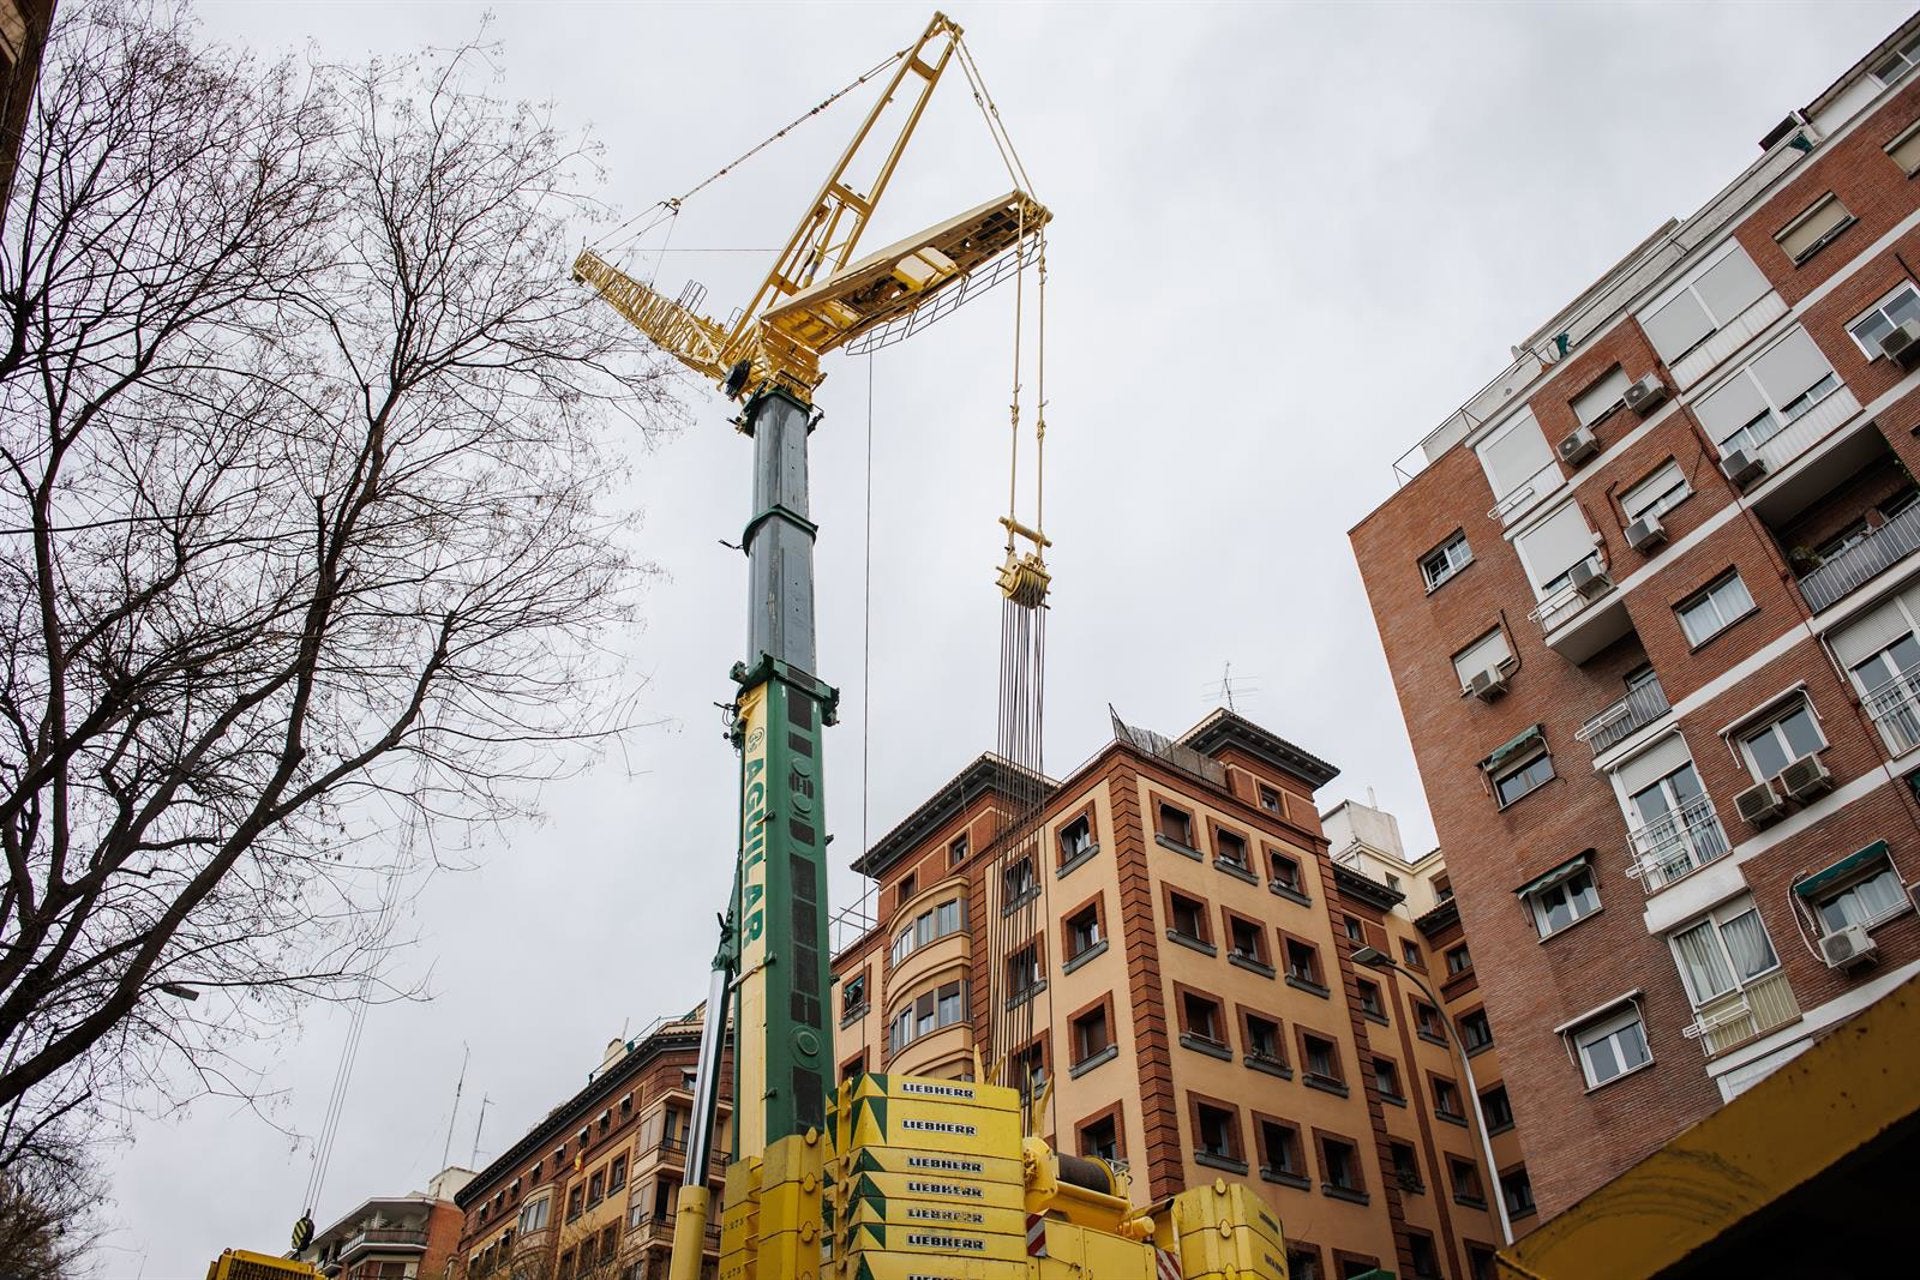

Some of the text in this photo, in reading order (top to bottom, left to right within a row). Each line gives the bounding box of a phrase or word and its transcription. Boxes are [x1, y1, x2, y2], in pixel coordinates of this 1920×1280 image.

[744, 758, 764, 949] AGUILAR
[903, 1083, 974, 1098] LIEBHERR
[903, 1120, 976, 1135] LIEBHERR
[909, 1158, 982, 1172] LIEBHERR
[909, 1182, 983, 1197] LIEBHERR
[908, 1235, 984, 1249] LIEBHERR
